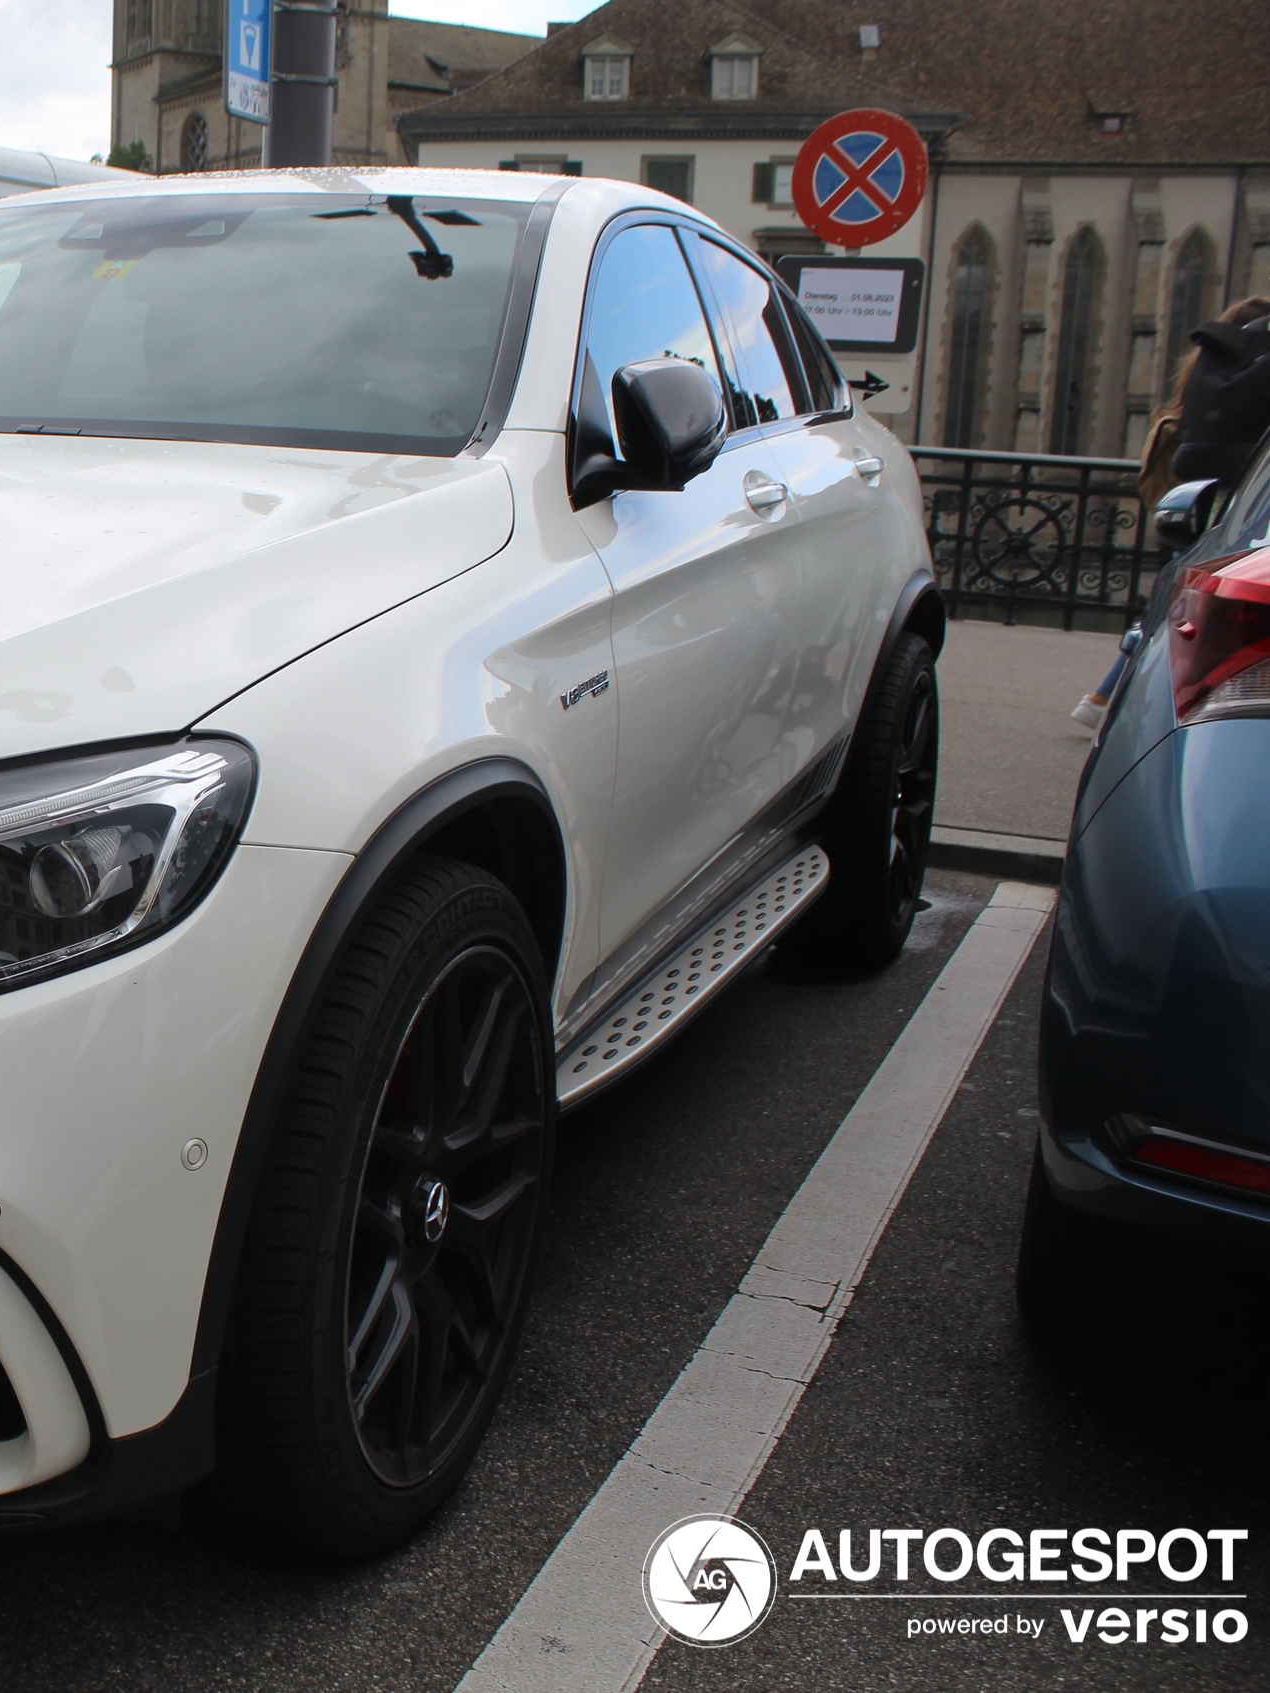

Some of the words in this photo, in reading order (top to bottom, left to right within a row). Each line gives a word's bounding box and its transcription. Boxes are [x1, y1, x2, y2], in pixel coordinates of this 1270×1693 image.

[804, 292, 838, 302] Dienstag
[828, 307, 843, 315] Uhr
[877, 308, 893, 317] Uhr
